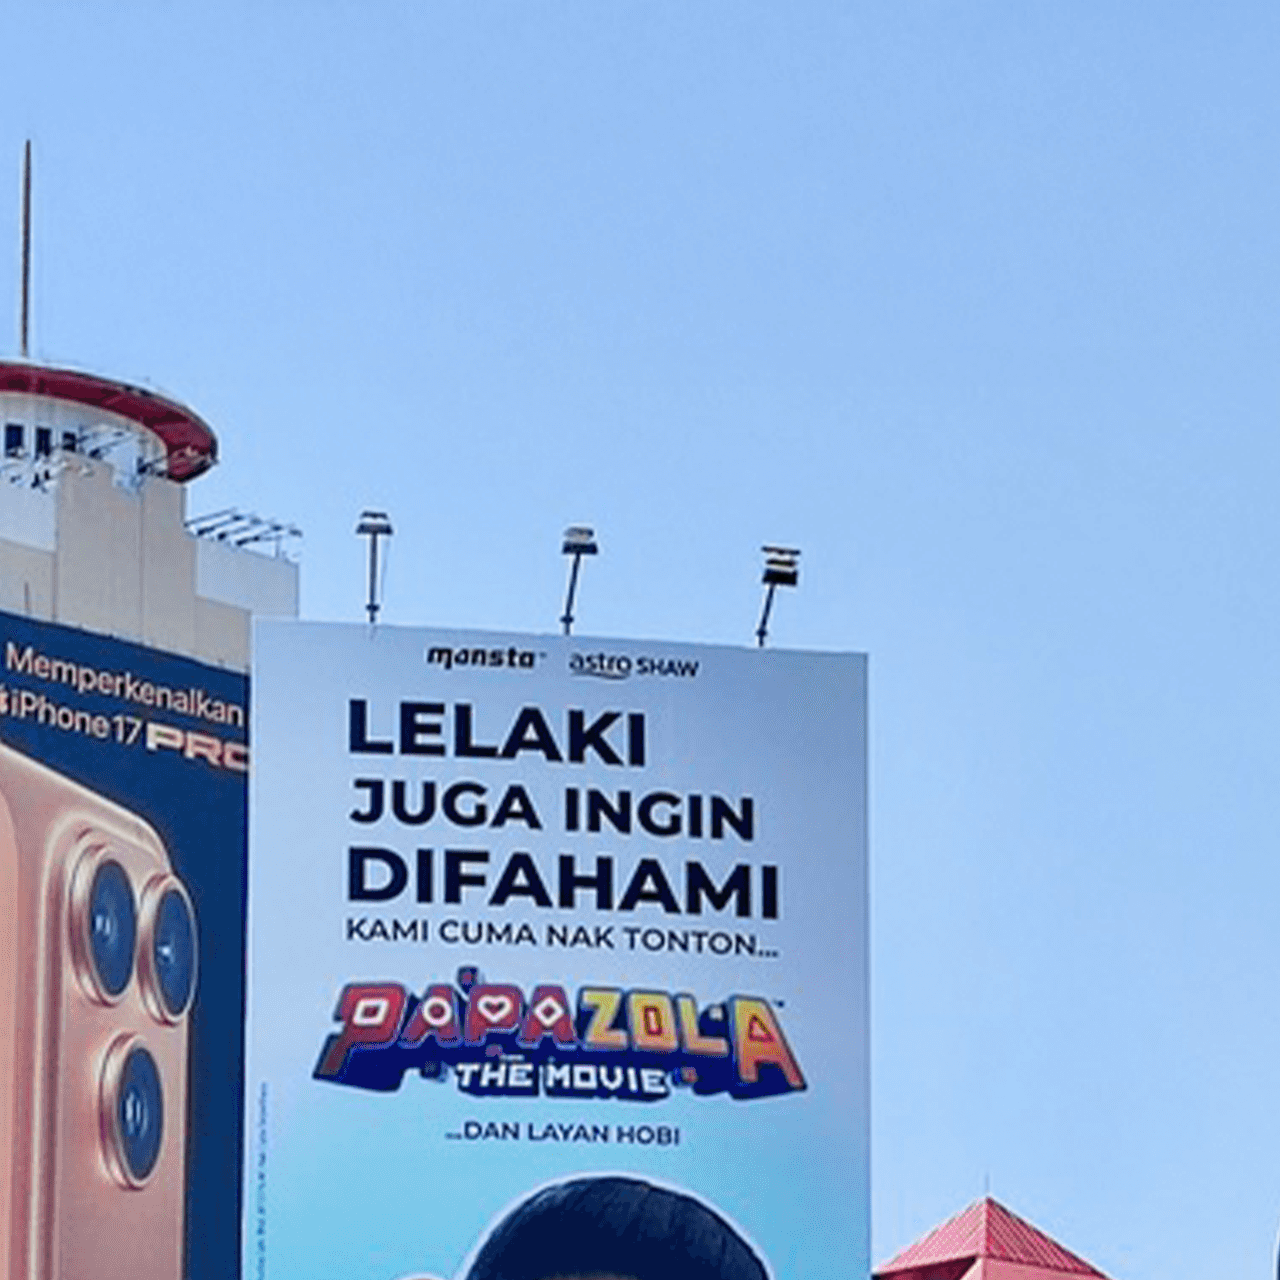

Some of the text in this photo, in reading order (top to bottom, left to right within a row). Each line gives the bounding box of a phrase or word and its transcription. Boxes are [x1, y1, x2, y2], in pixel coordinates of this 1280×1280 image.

[7, 642, 243, 725] Memperkenalkan
[569, 652, 700, 681] astro SHAW
[12, 688, 109, 737] iPhone
[114, 717, 142, 743] 17
[349, 700, 645, 767] LELAKI
[349, 778, 755, 841] JUGA INGIN
[348, 847, 778, 919] DIFAHAMI
[346, 918, 780, 958] KAMI CUMA NAK TONTON...
[313, 972, 808, 1101] PAPAZOLA
[456, 1061, 670, 1096] THE MOVIE
[445, 1119, 681, 1145] ...DAN LAYAN HOBI
